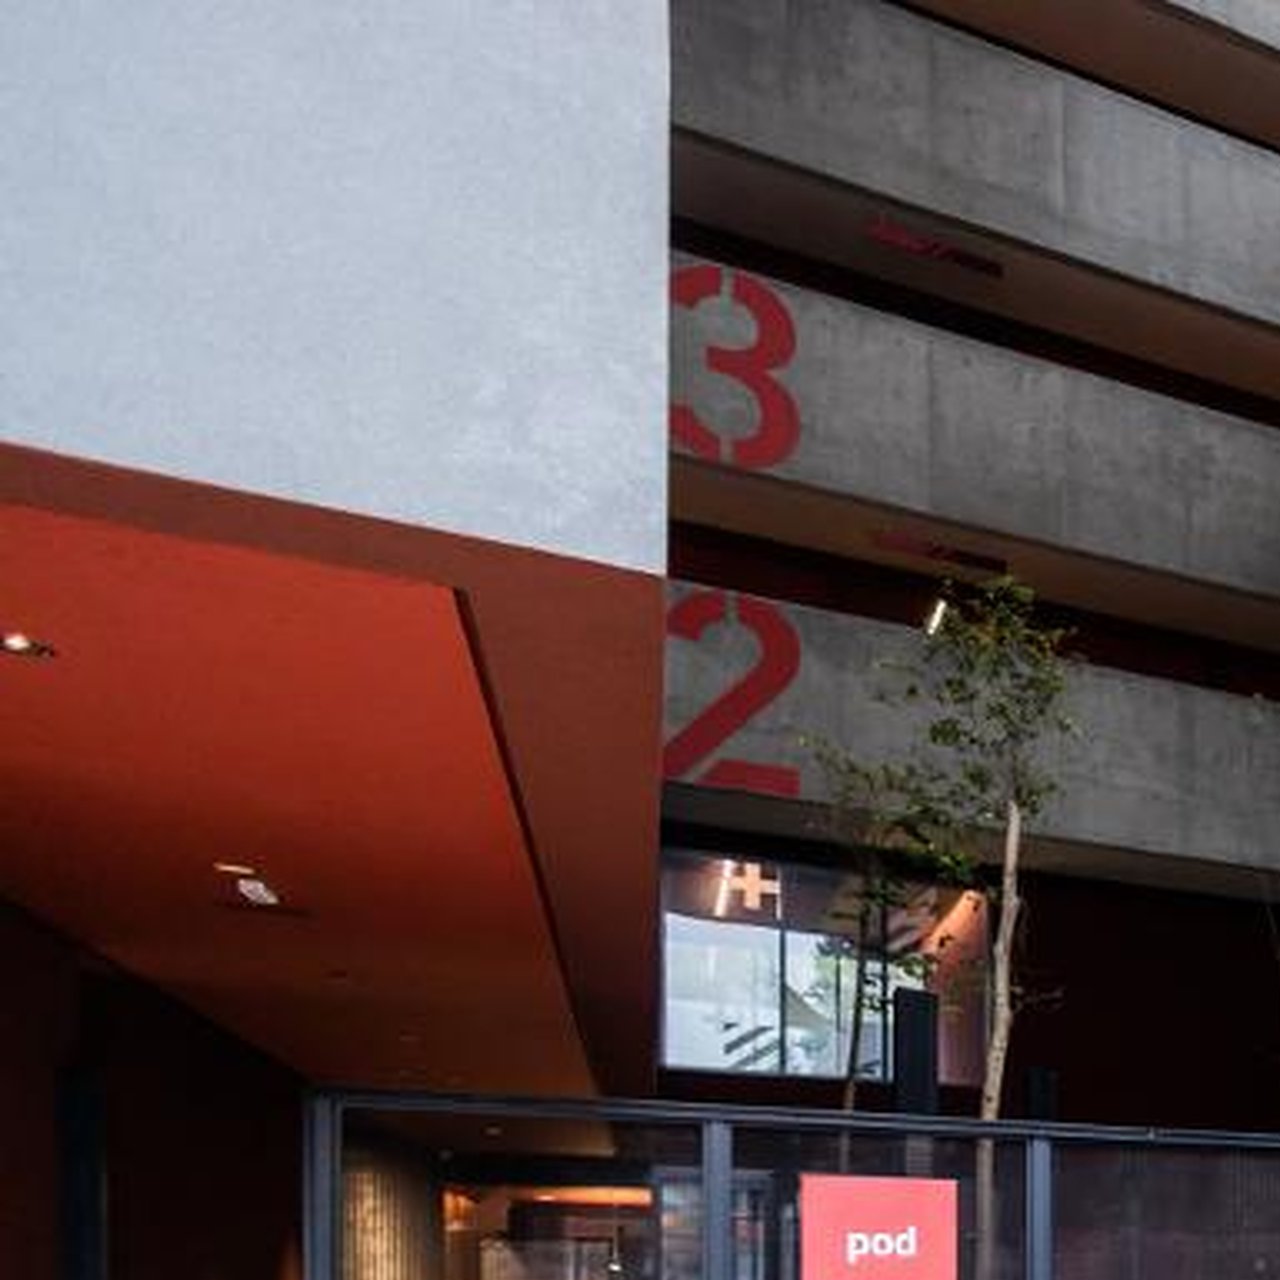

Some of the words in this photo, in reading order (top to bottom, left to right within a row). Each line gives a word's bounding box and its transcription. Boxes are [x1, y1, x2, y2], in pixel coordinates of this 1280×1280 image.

[668, 265, 799, 468] 3
[664, 587, 801, 797] 2
[846, 1226, 918, 1263] pod
